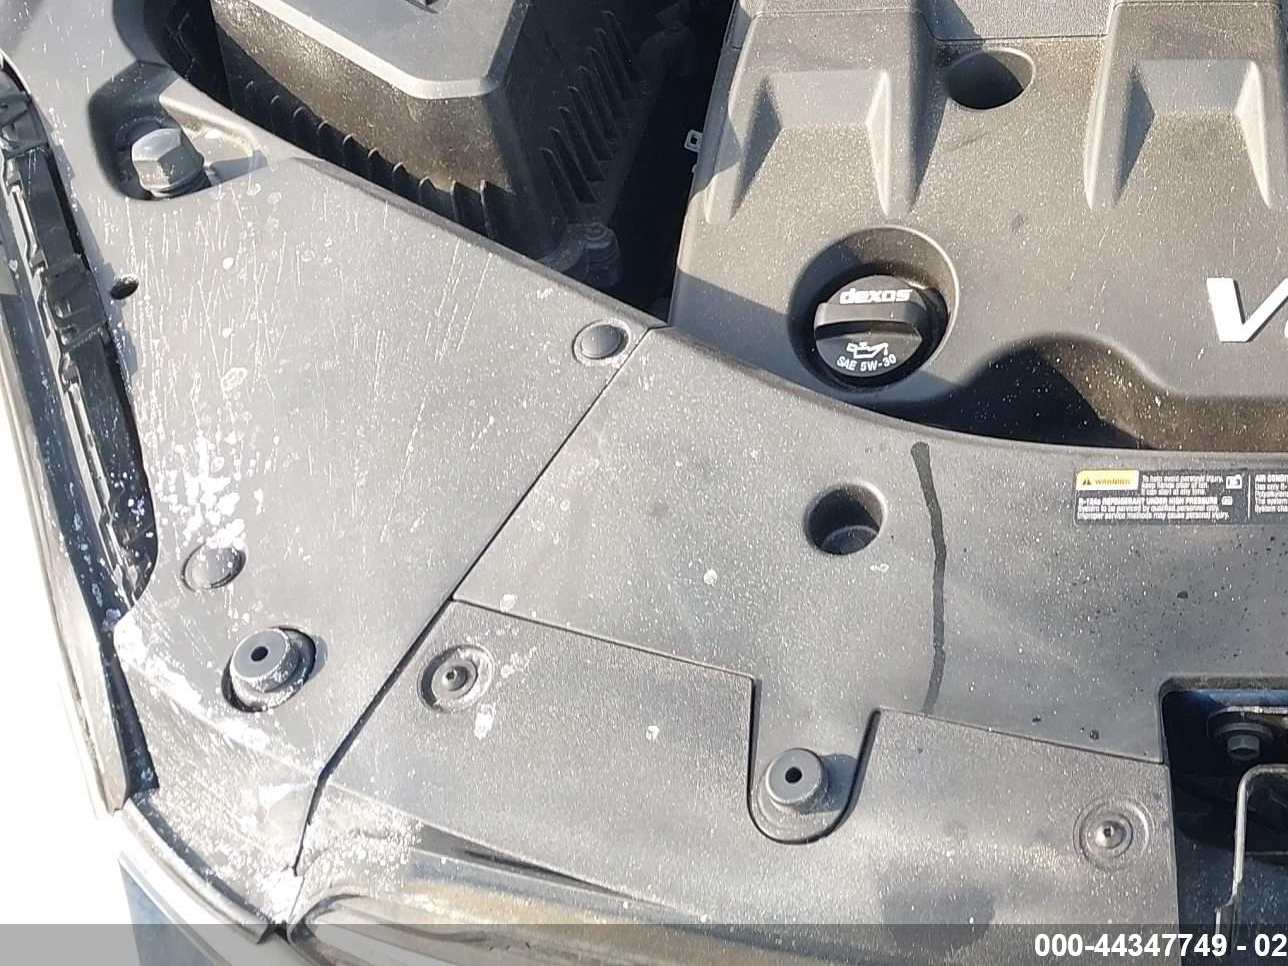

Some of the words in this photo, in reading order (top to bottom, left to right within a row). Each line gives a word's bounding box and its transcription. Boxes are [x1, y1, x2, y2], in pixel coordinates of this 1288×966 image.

[839, 287, 914, 305] dexos
[836, 355, 858, 371] SAE
[860, 353, 897, 372] 5W-30
